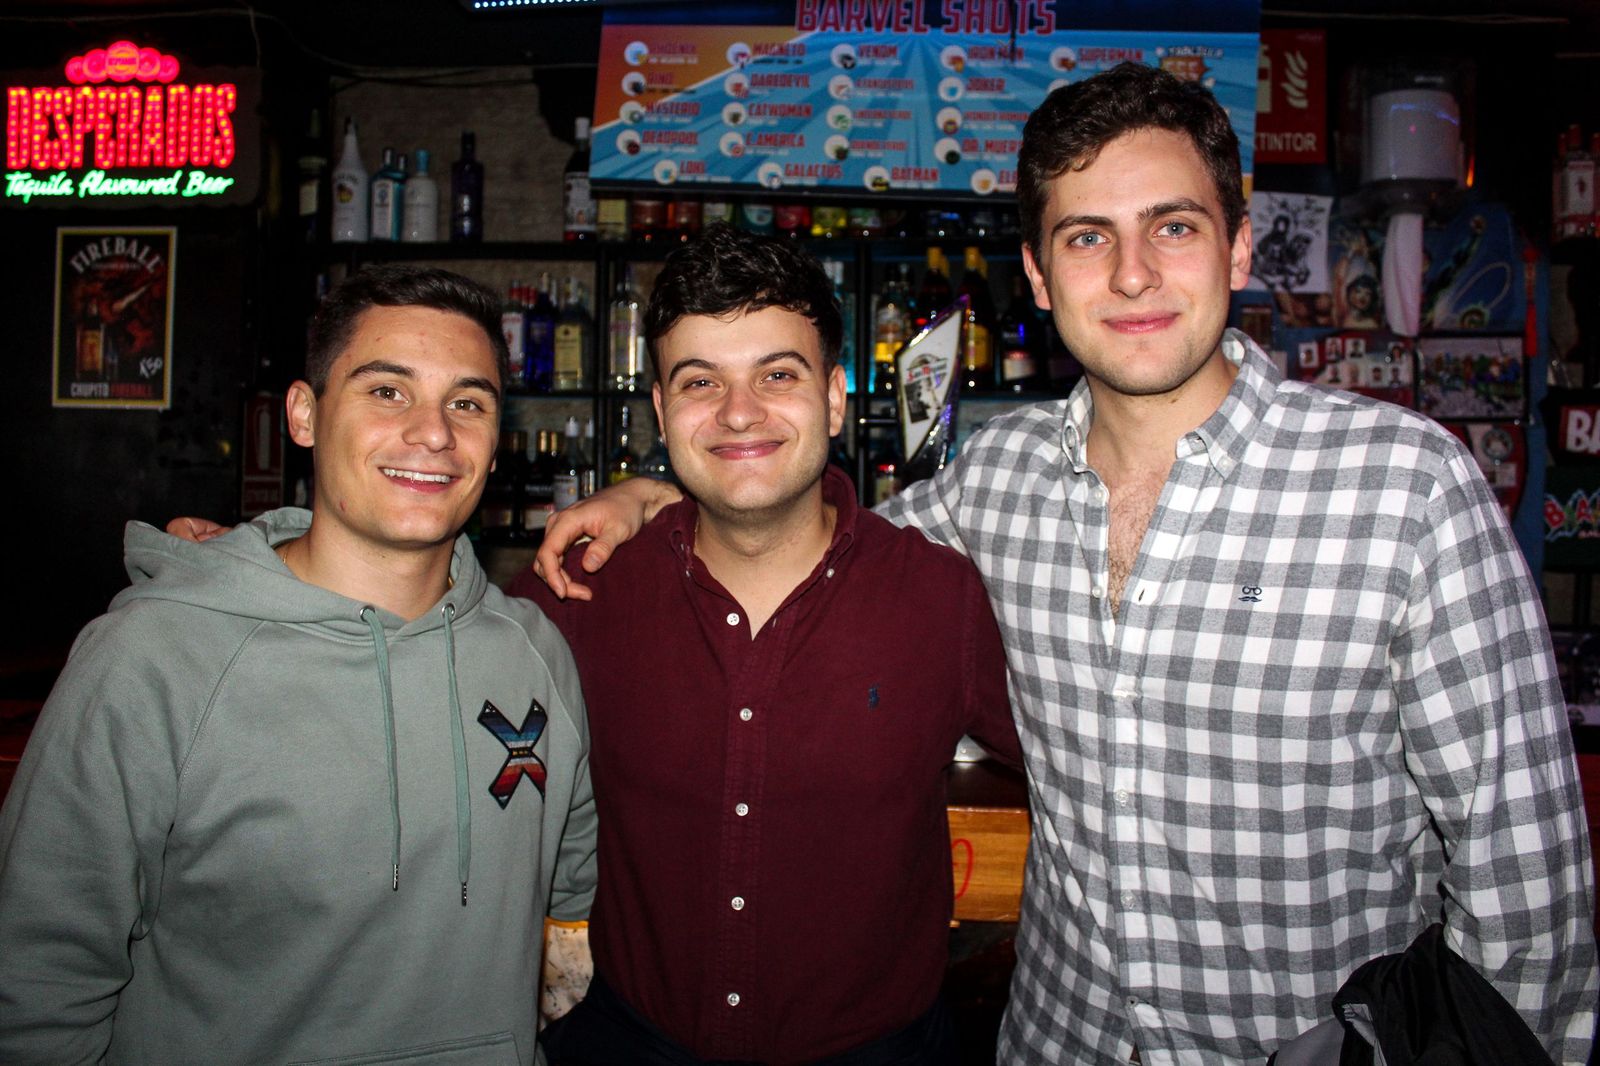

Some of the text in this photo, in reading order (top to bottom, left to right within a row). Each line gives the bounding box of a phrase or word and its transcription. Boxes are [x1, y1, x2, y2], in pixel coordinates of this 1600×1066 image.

[796, 0, 1056, 35] BARVEL SHOTS
[7, 84, 236, 169] DESPERADOS
[1255, 132, 1317, 152] TINTOR
[5, 170, 235, 203] Tequila Flavoured Beer
[70, 236, 165, 275] FIREBALL
